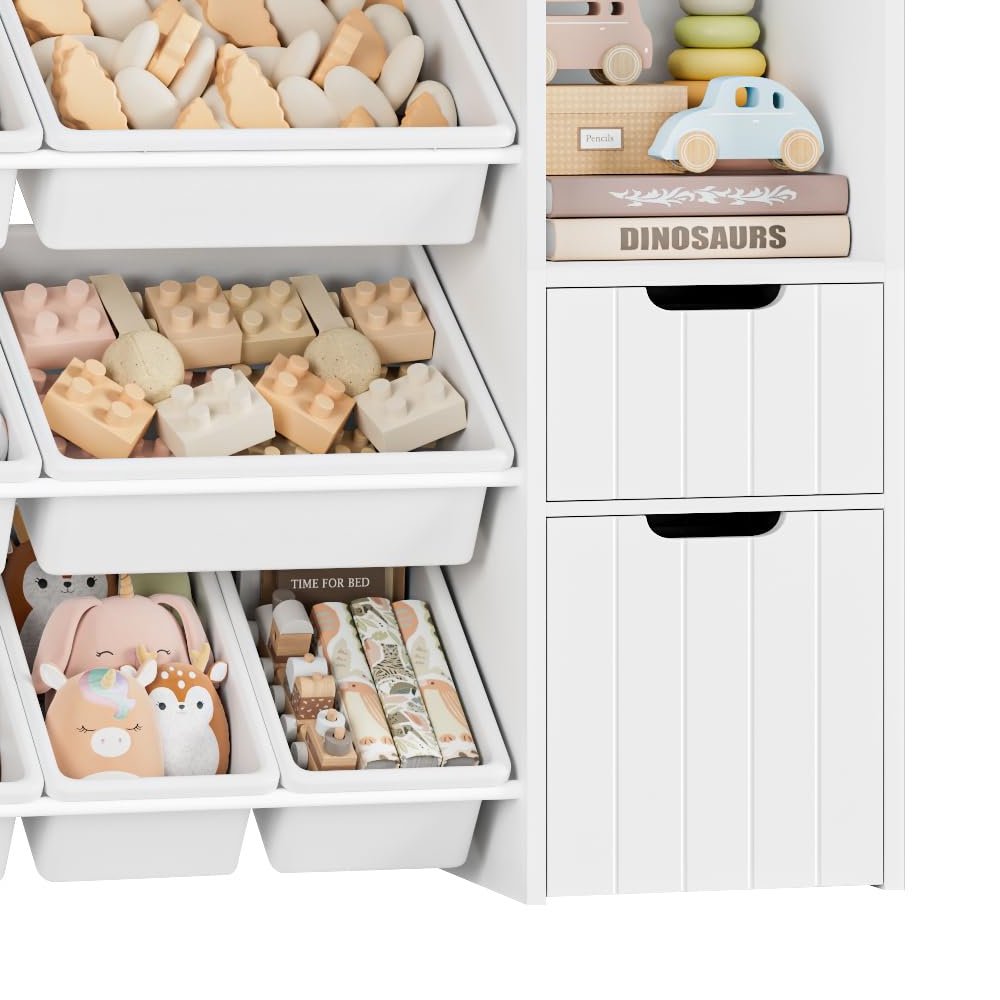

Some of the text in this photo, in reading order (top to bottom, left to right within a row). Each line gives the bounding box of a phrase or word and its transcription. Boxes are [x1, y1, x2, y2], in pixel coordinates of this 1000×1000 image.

[620, 224, 787, 251] DINOSAURS
[290, 577, 370, 589] TIME FOR BED
